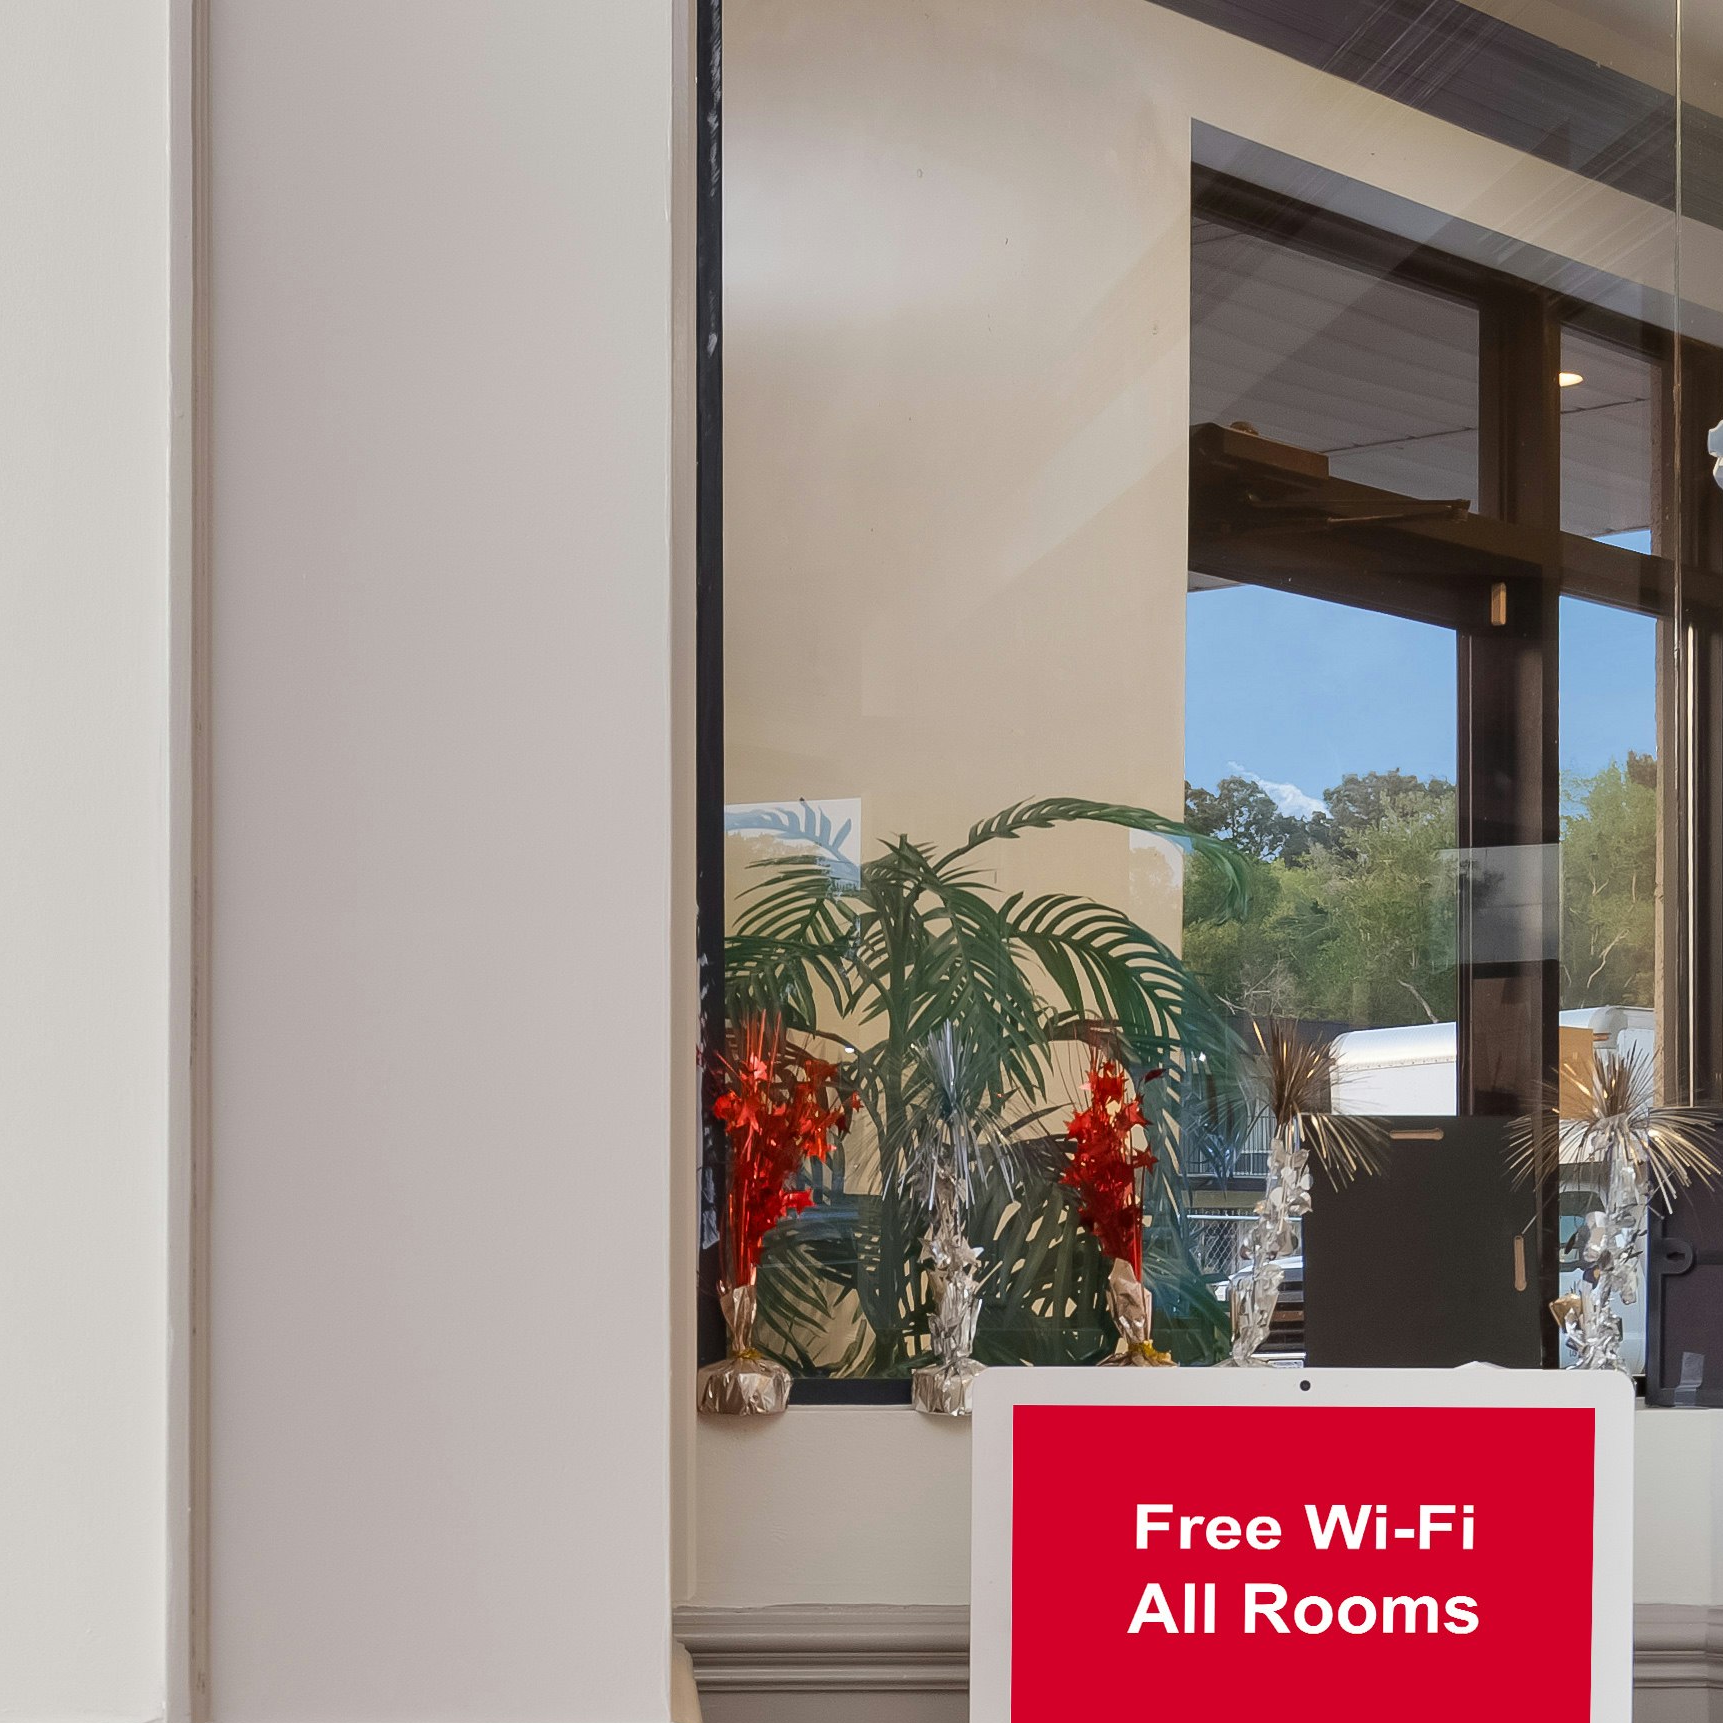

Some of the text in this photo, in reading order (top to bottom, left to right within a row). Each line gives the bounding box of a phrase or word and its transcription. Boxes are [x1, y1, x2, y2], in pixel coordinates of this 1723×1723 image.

[1136, 1503, 1475, 1550] Free Wi-Fi
[1126, 1582, 1480, 1635] All Rooms
